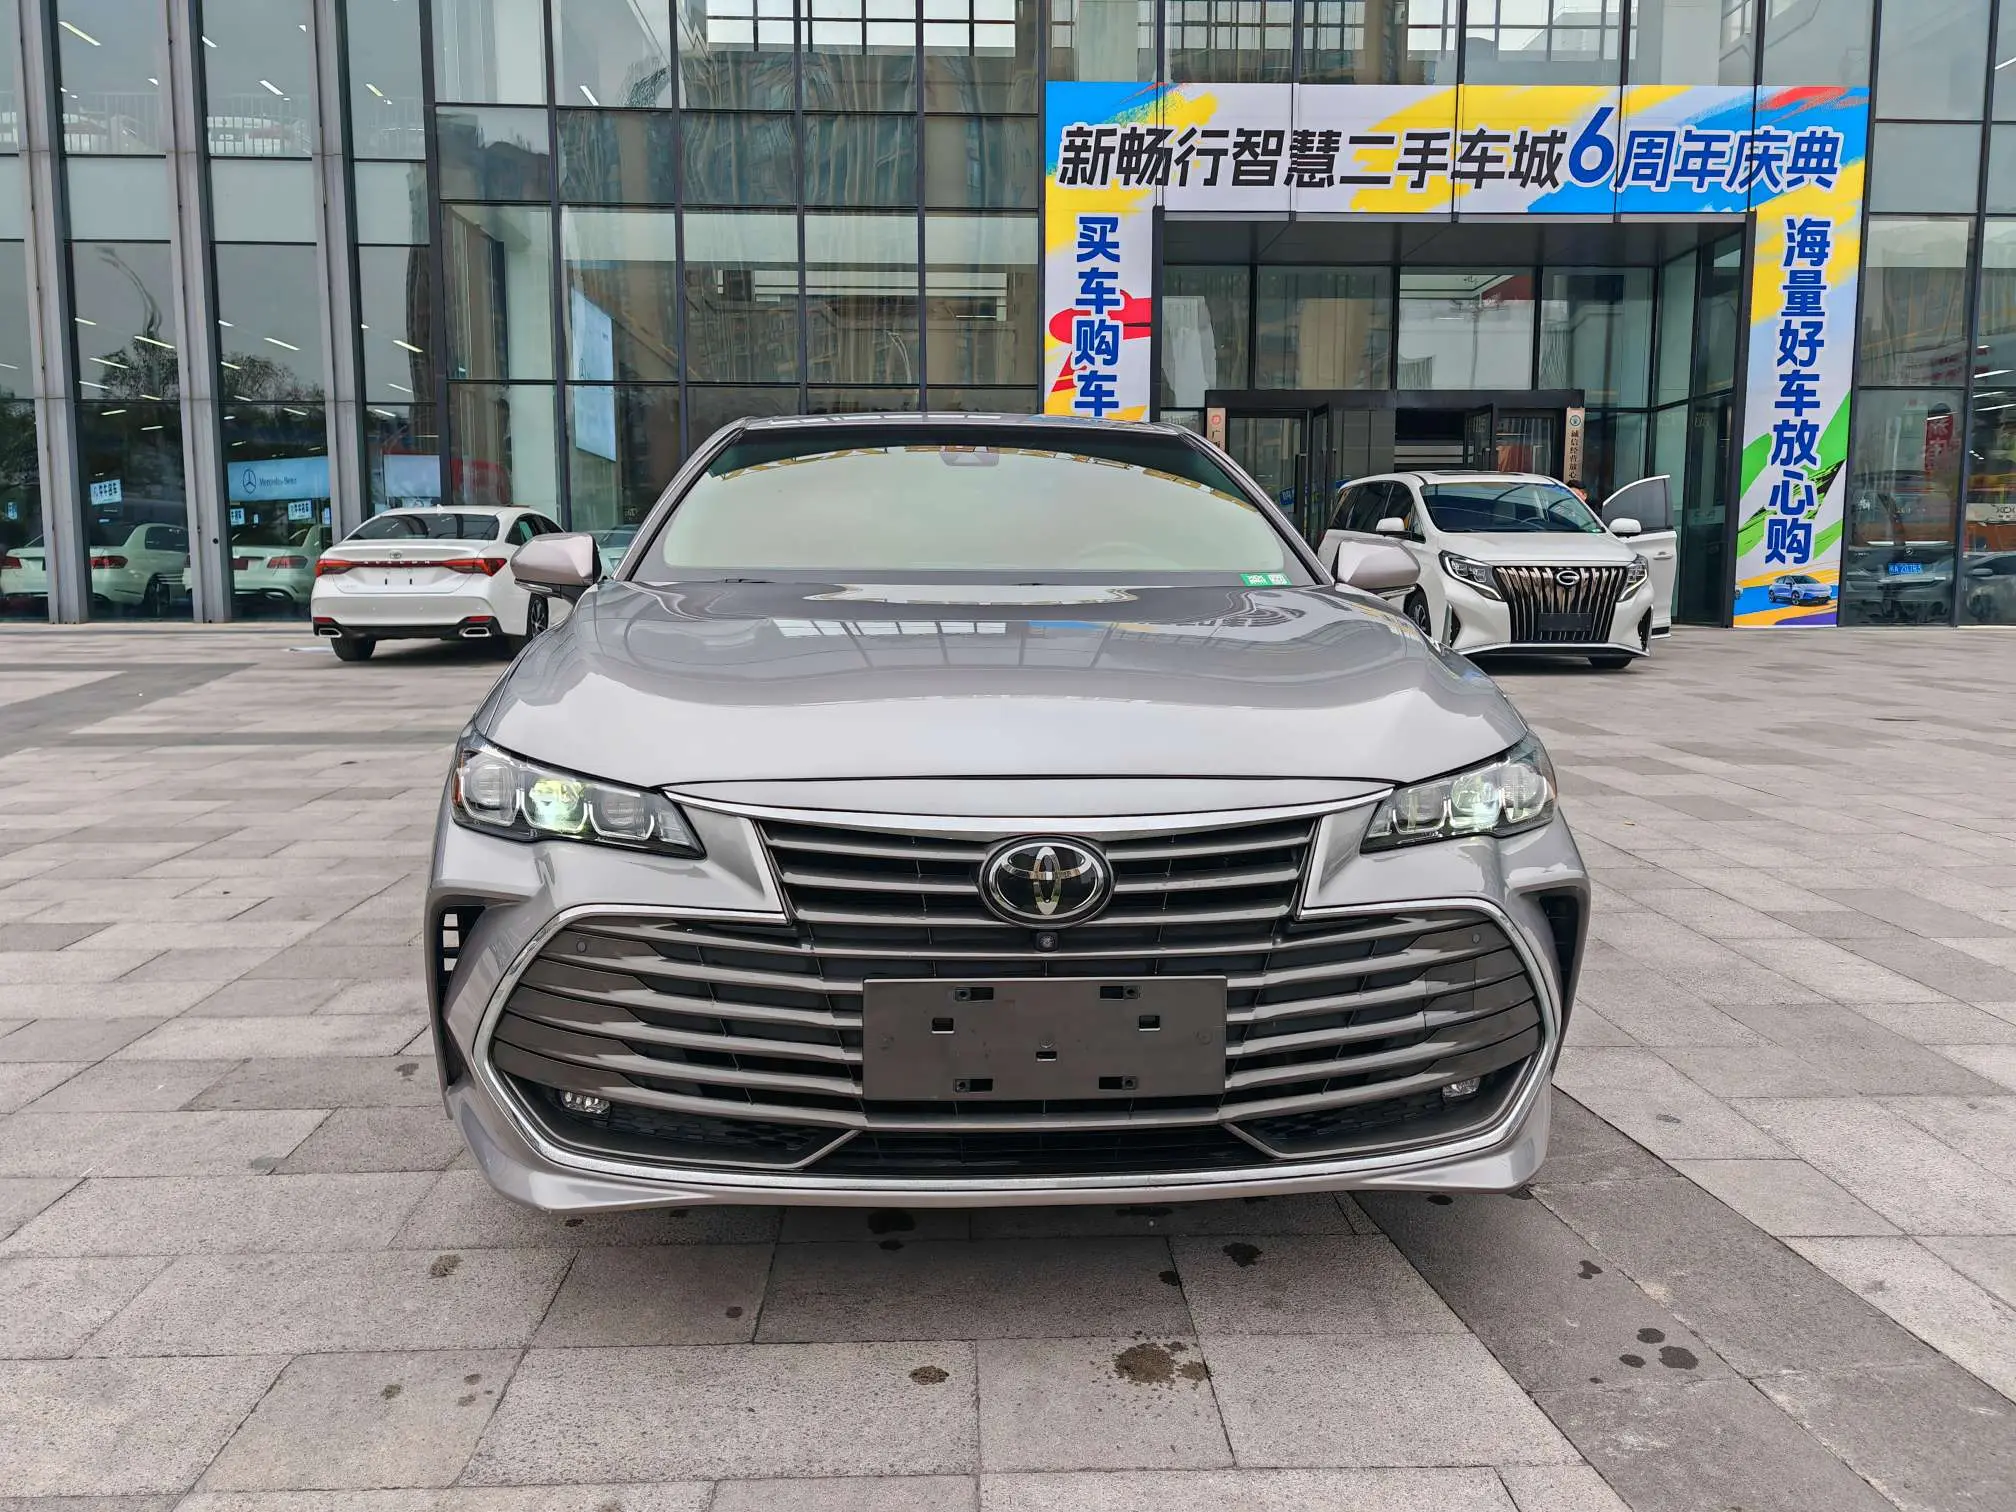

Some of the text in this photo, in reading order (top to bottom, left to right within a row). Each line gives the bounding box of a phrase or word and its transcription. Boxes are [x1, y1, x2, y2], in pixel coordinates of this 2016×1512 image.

[1058, 106, 1841, 191] 新畅行智慧二手车城6周年庆典
[1075, 216, 1121, 417] 买车购车
[1764, 217, 1831, 566] 海量好车放心购
